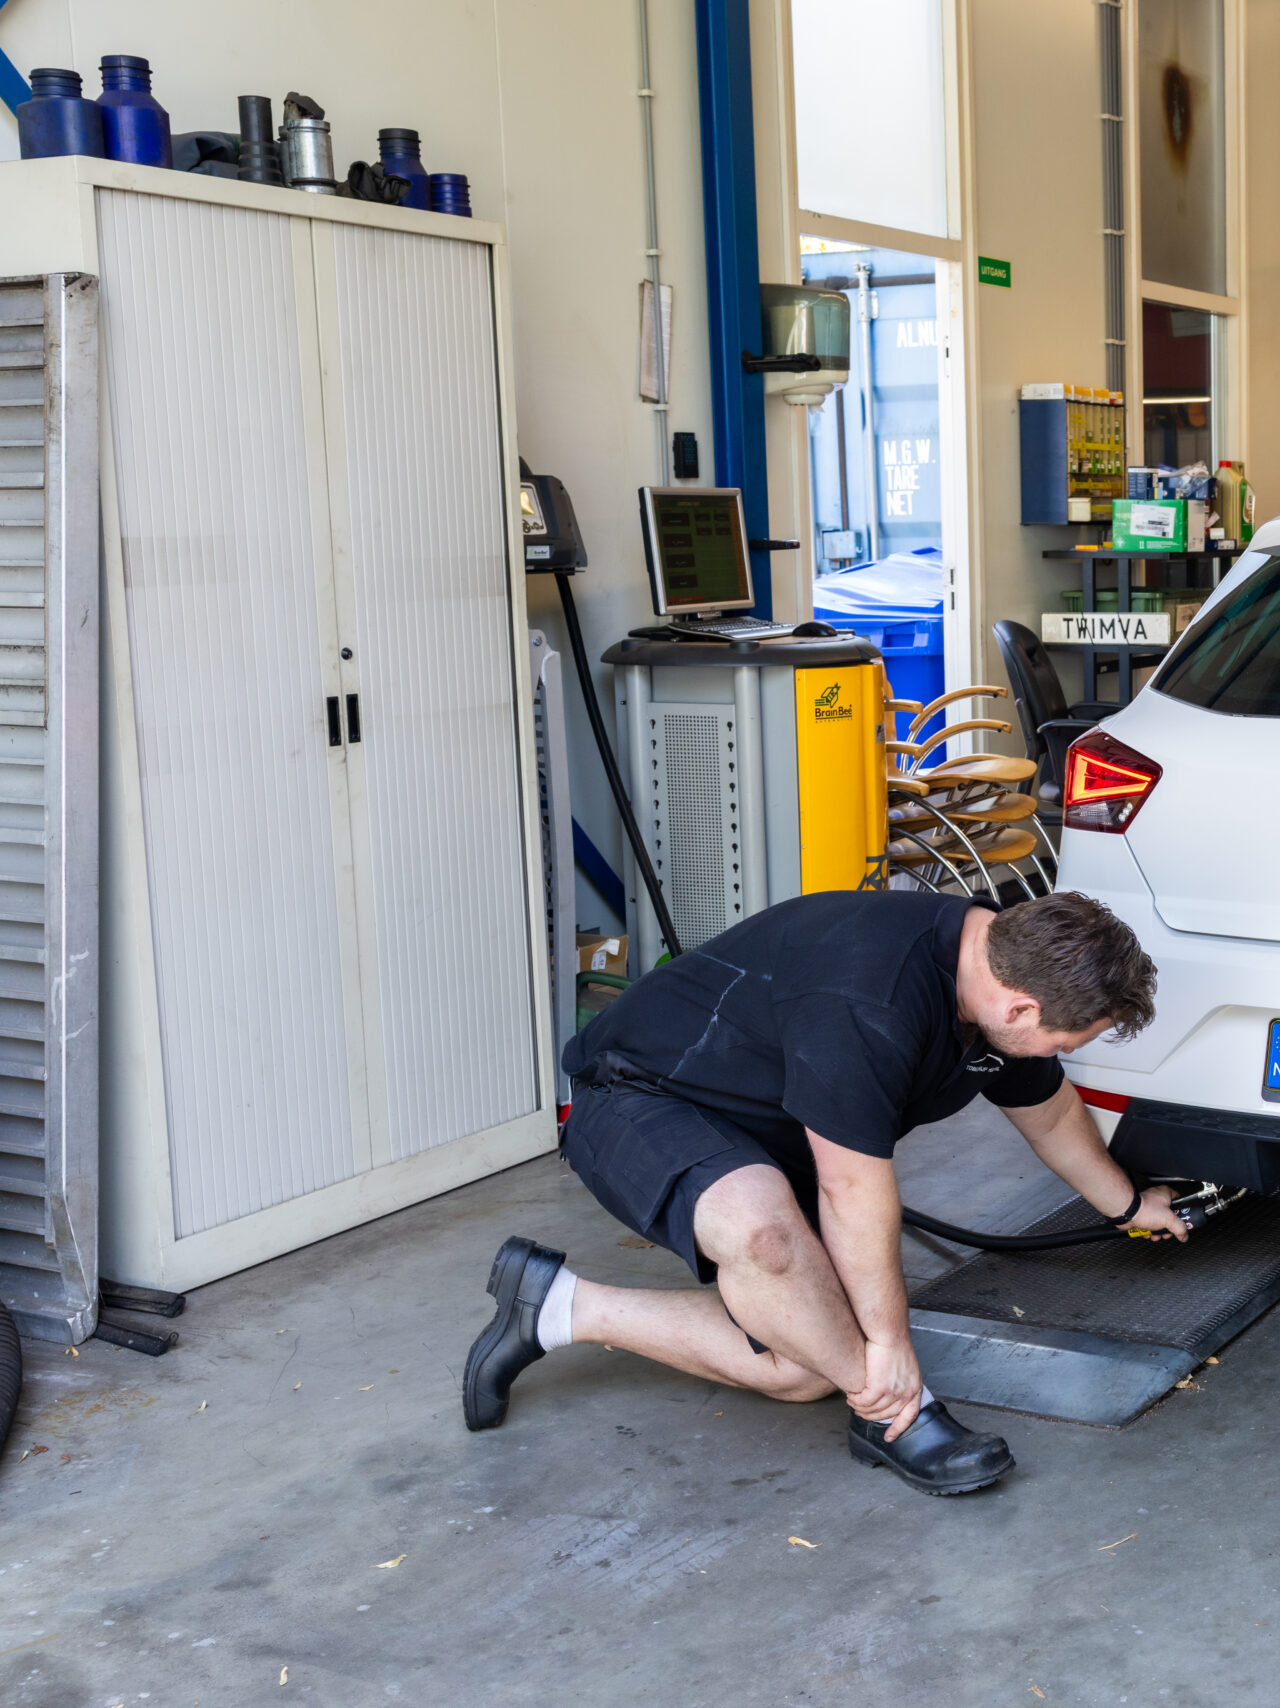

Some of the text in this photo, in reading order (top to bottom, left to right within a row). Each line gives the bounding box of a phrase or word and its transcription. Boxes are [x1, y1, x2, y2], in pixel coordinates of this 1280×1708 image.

[981, 265, 1007, 278] UITGANG
[883, 438, 936, 465] M.G.W.
[885, 465, 920, 490] TARE
[886, 491, 914, 516] NET
